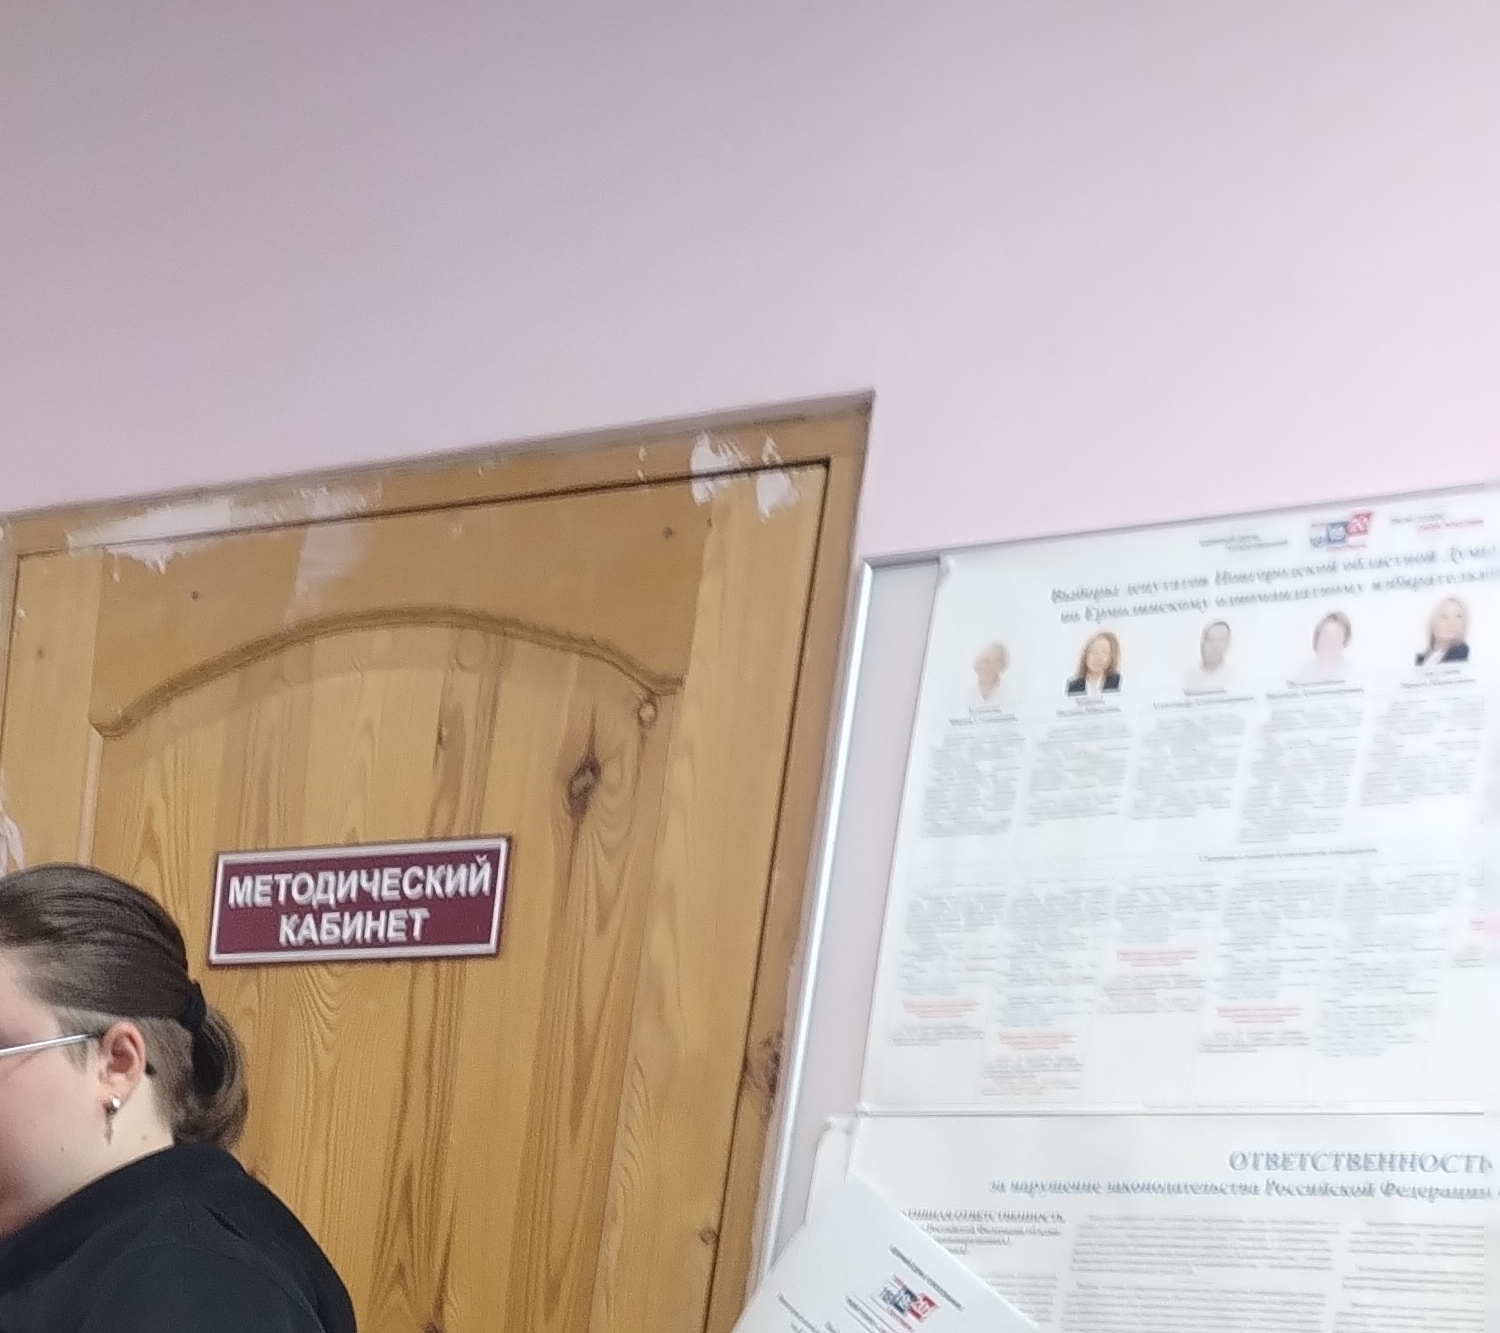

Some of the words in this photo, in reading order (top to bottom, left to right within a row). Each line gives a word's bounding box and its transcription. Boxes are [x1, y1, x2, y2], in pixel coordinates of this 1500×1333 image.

[228, 853, 492, 909] МЕТОДИЧЕСКИЙ
[279, 908, 430, 946] КАБИНЕТ
[1228, 1149, 1493, 1174] ОТВЕТСТВЕННОСТЬ
